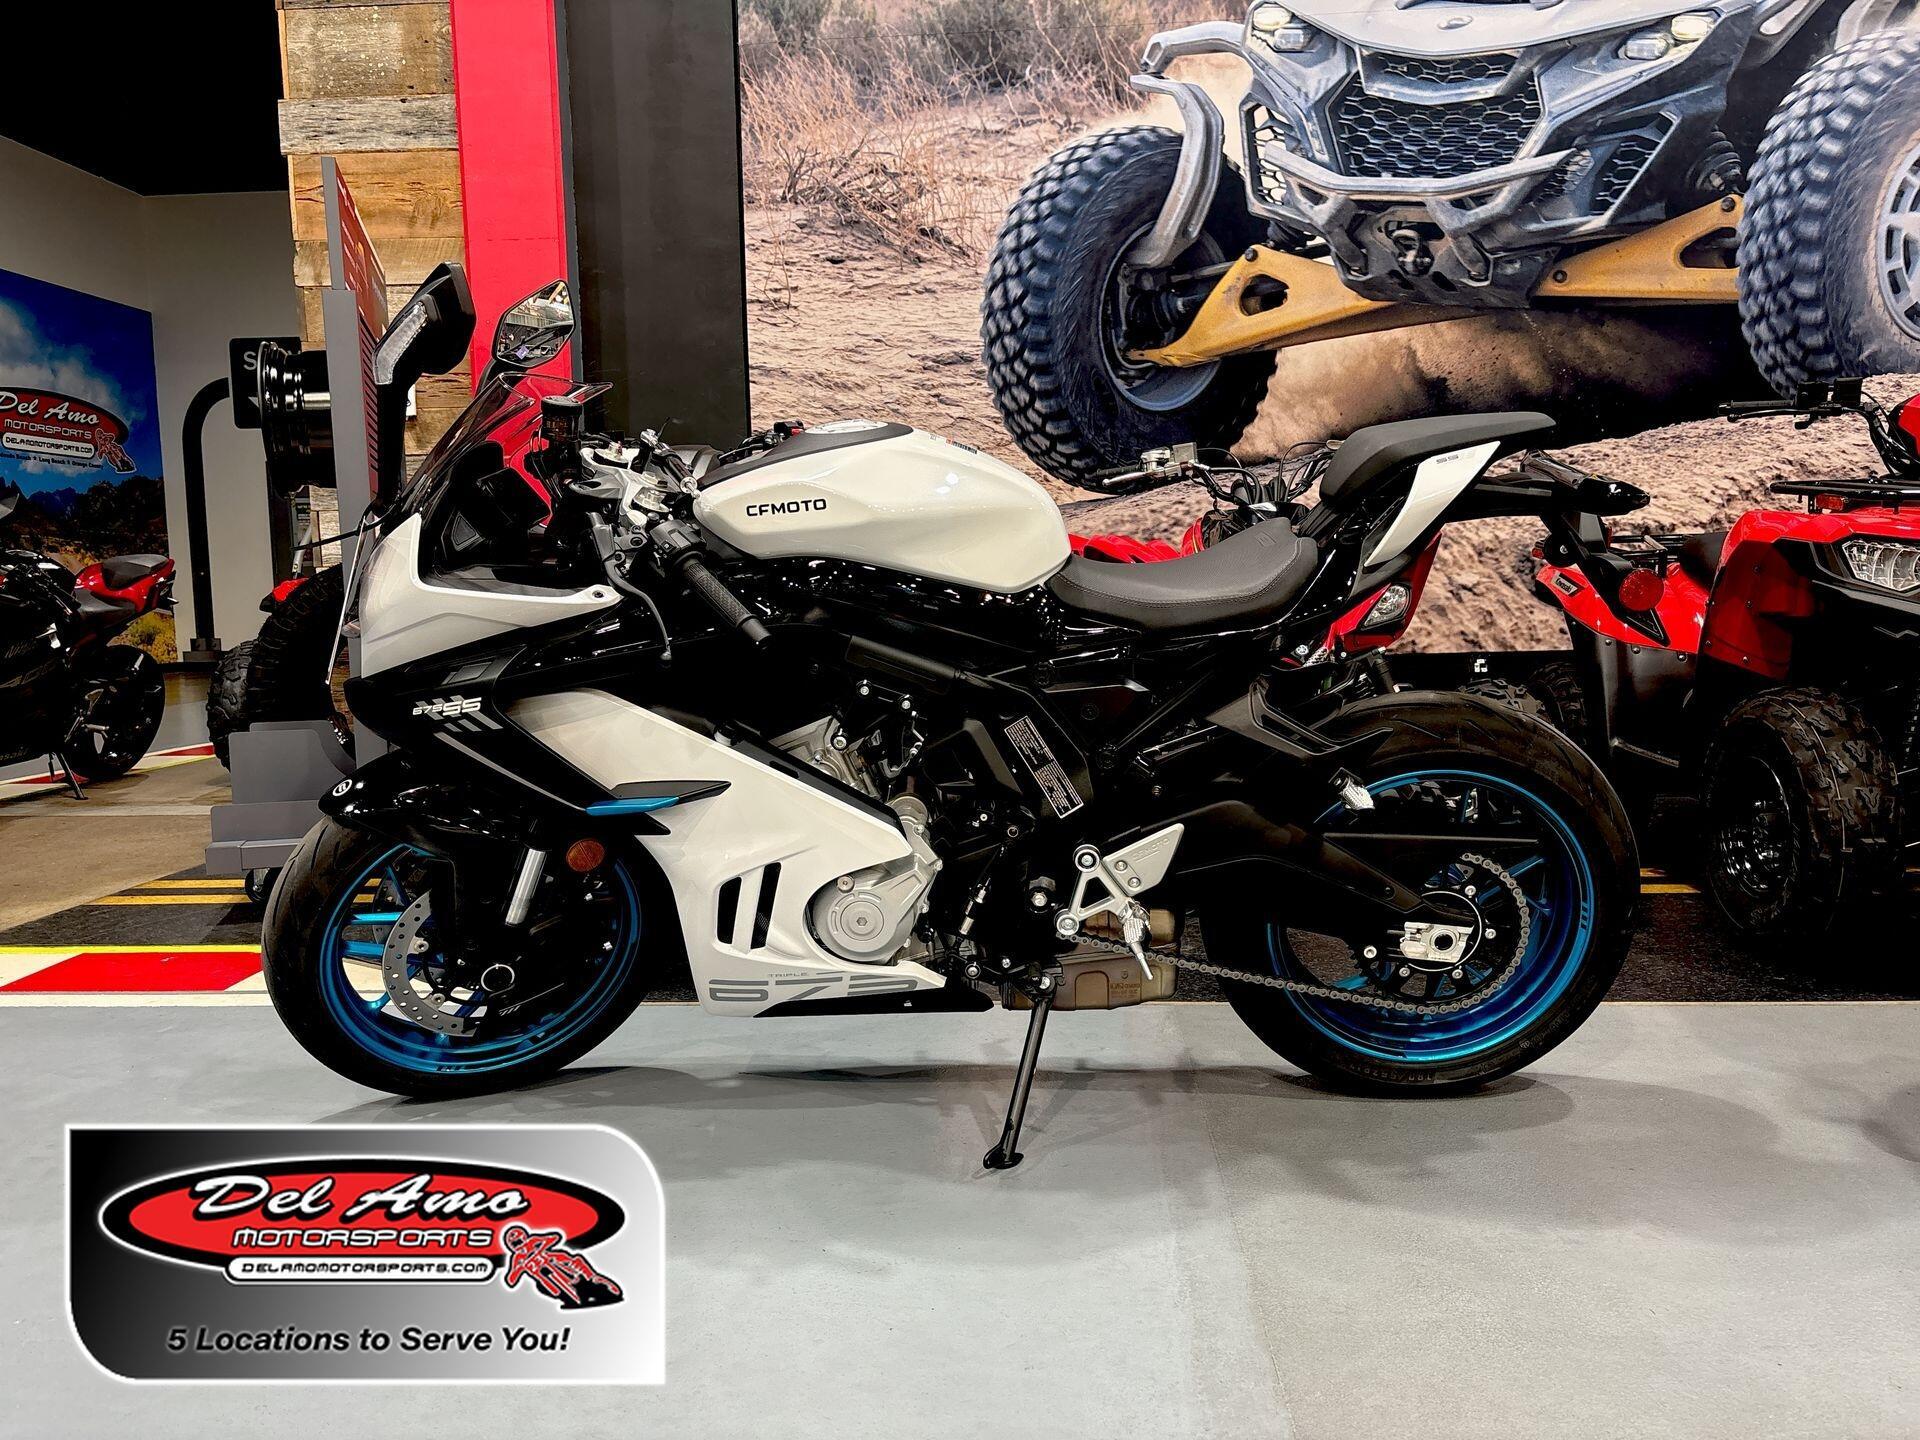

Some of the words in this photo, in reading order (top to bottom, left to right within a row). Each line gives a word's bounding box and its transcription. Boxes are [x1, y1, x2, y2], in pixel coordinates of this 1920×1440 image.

[0, 391, 39, 415] Del
[43, 402, 100, 425] Amo
[4, 419, 93, 439] MOTORSPORTS
[746, 498, 827, 517] CFMOTO
